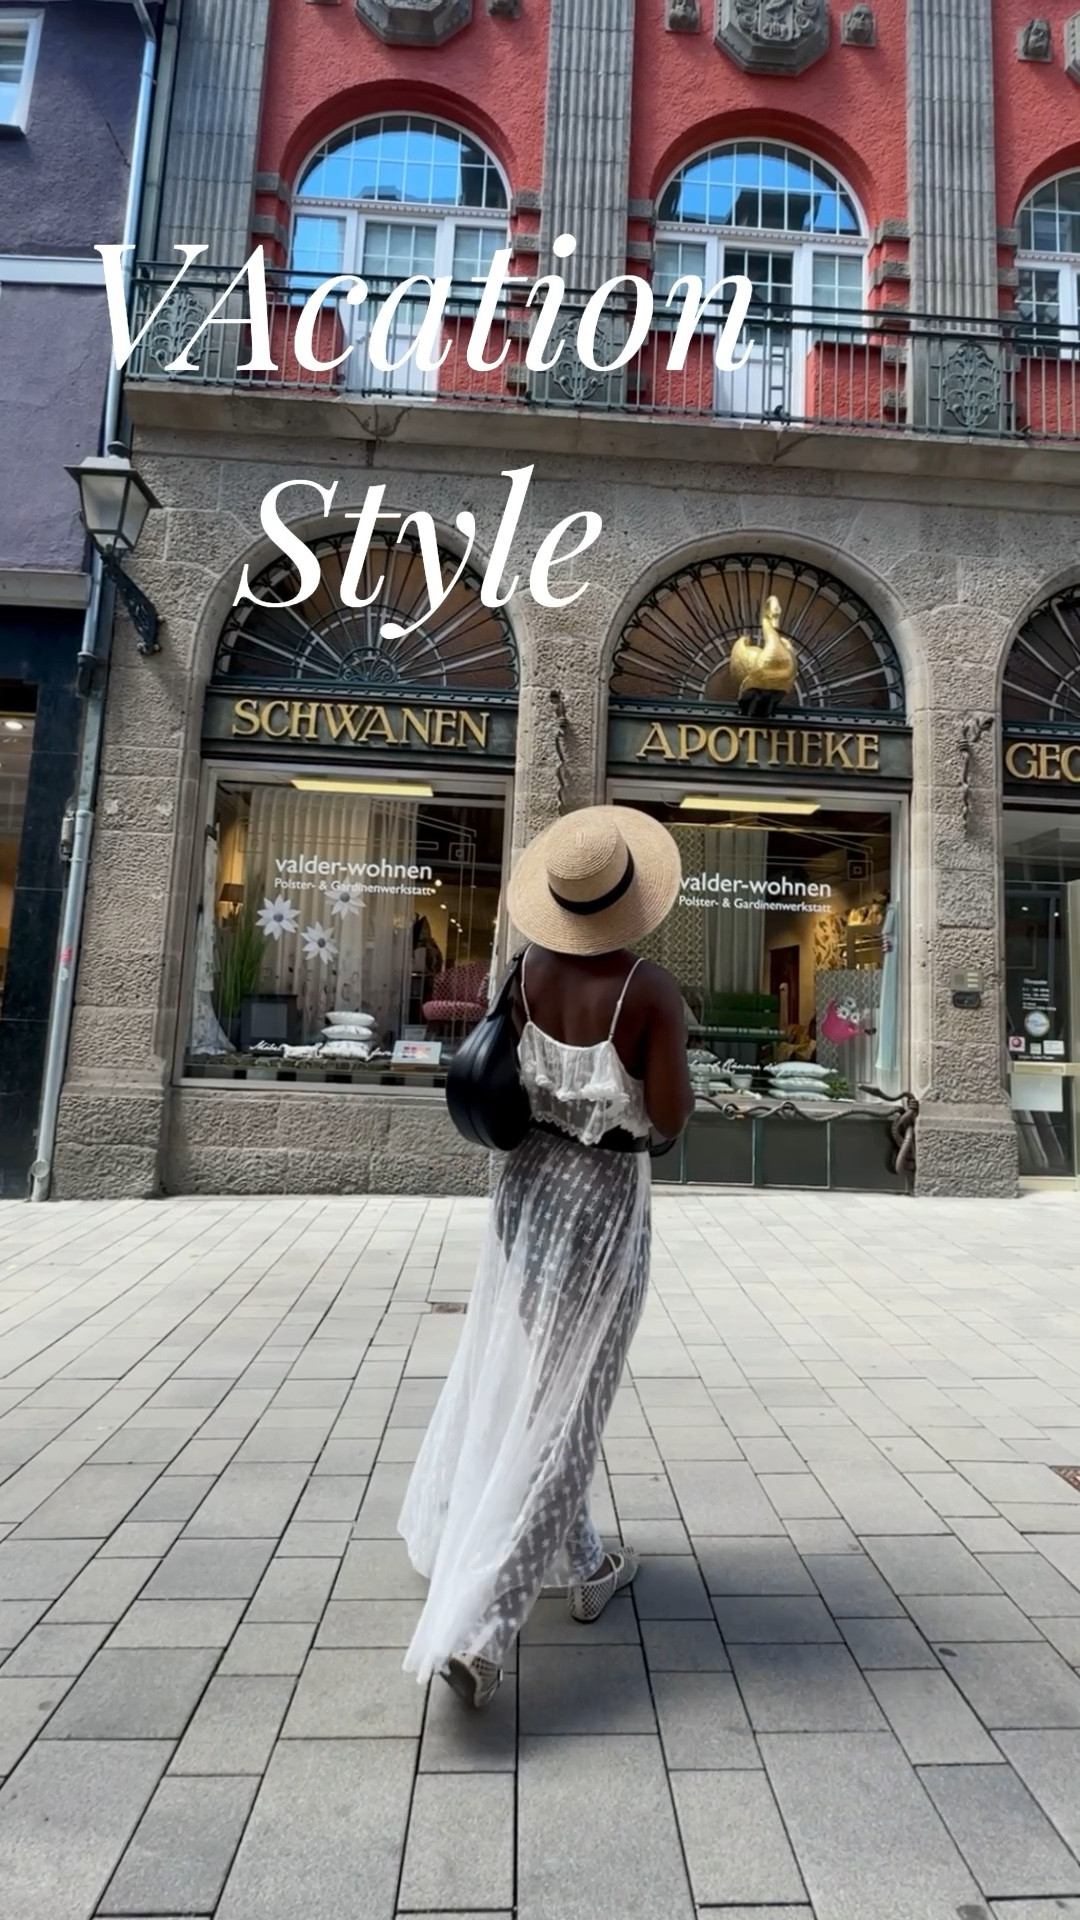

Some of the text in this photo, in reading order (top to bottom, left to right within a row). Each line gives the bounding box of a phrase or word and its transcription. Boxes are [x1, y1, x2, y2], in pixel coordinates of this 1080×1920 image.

[232, 699, 490, 748] SCHWANEN
[636, 722, 879, 770] APOTHEKE
[276, 854, 432, 880] valder-wohnen
[274, 877, 316, 891] Polster-
[319, 880, 328, 891] &
[680, 872, 831, 898] valder-wohnen
[679, 895, 832, 913] Polster- & Gardinenwerkstatt
